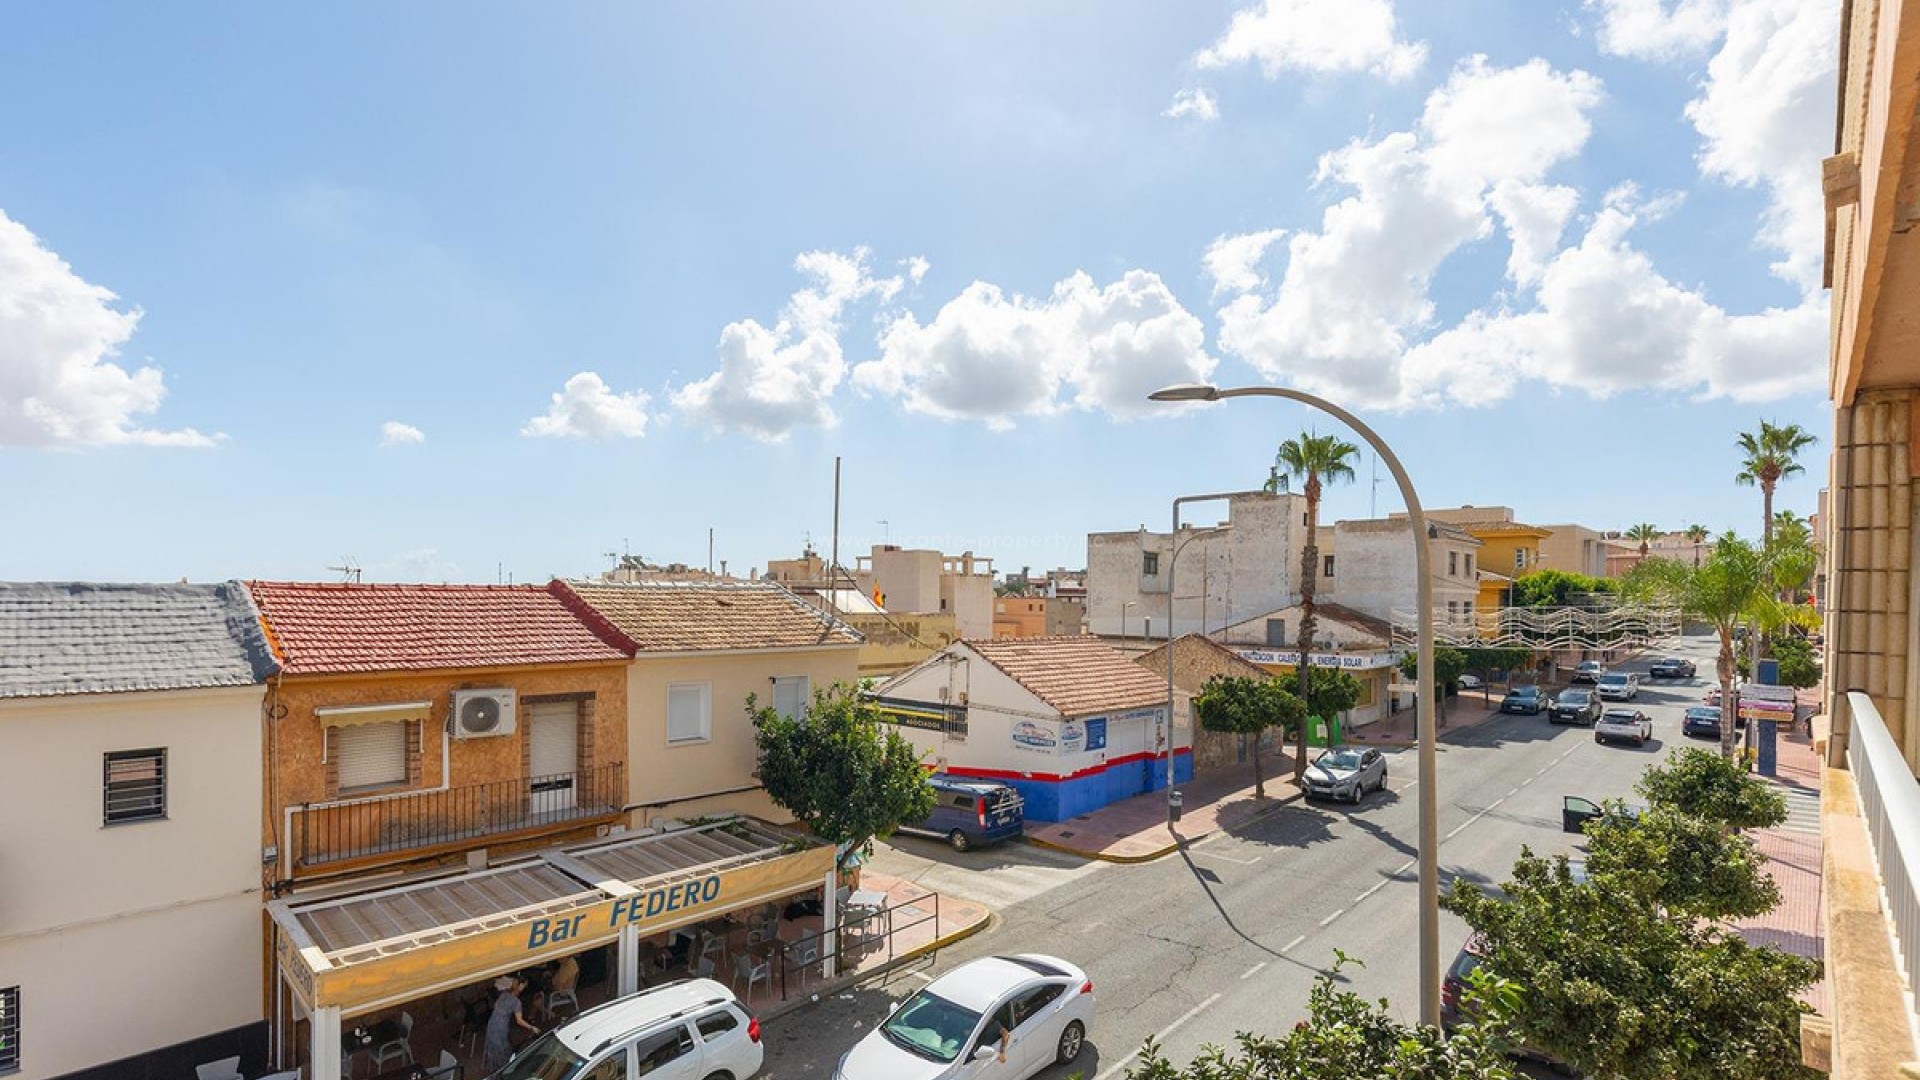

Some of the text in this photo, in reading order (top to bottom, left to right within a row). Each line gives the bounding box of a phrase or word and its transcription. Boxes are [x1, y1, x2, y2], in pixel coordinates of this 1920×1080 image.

[1343, 657, 1363, 667] SOLAR
[527, 875, 721, 949] Bar FEDERO
